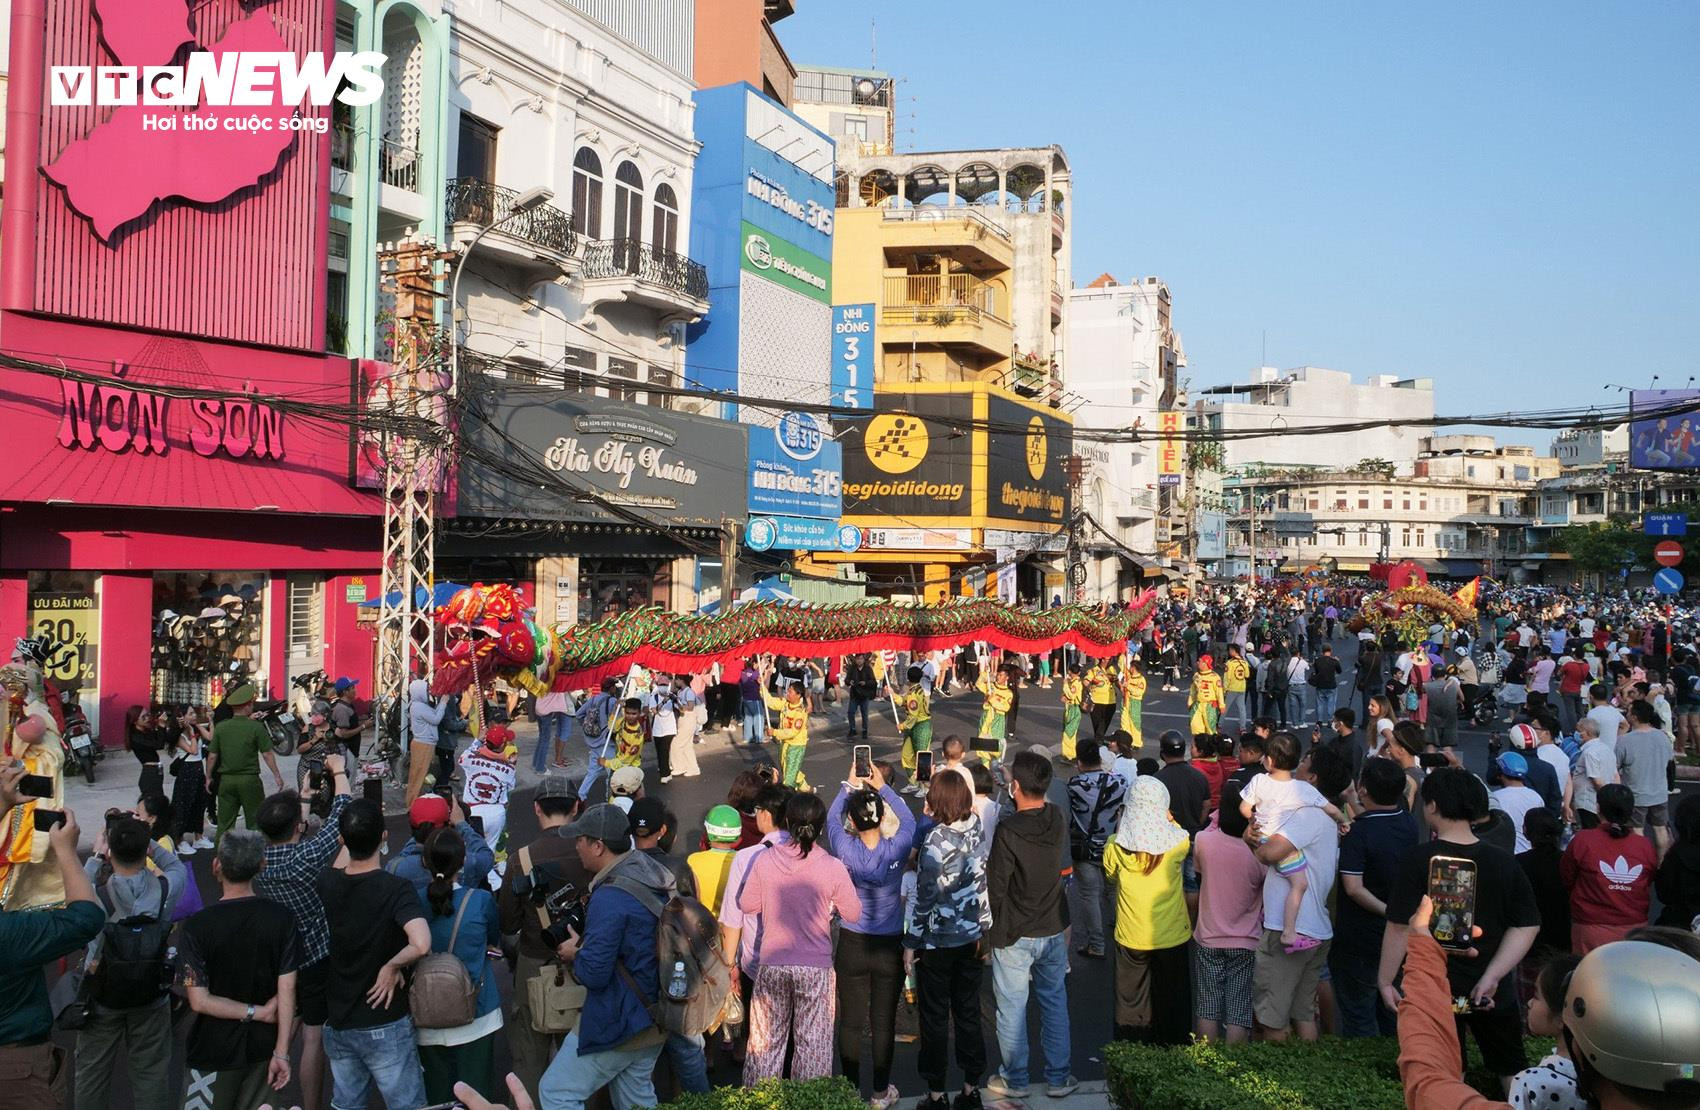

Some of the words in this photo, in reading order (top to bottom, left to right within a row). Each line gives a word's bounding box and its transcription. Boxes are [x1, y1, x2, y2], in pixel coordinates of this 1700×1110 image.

[806, 199, 833, 235] 315
[843, 308, 862, 320] NHI
[836, 320, 870, 333] ĐỒNG
[800, 428, 819, 450] 315
[638, 445, 698, 487] Xuân
[756, 460, 773, 470] Phòng
[754, 470, 776, 490] NHI
[777, 468, 811, 494] ĐỒNG
[812, 469, 840, 497] 315
[842, 480, 964, 501] hegioididong
[34, 598, 50, 608] ƯU
[52, 596, 70, 608] ĐÃI
[73, 597, 93, 608] MỚI
